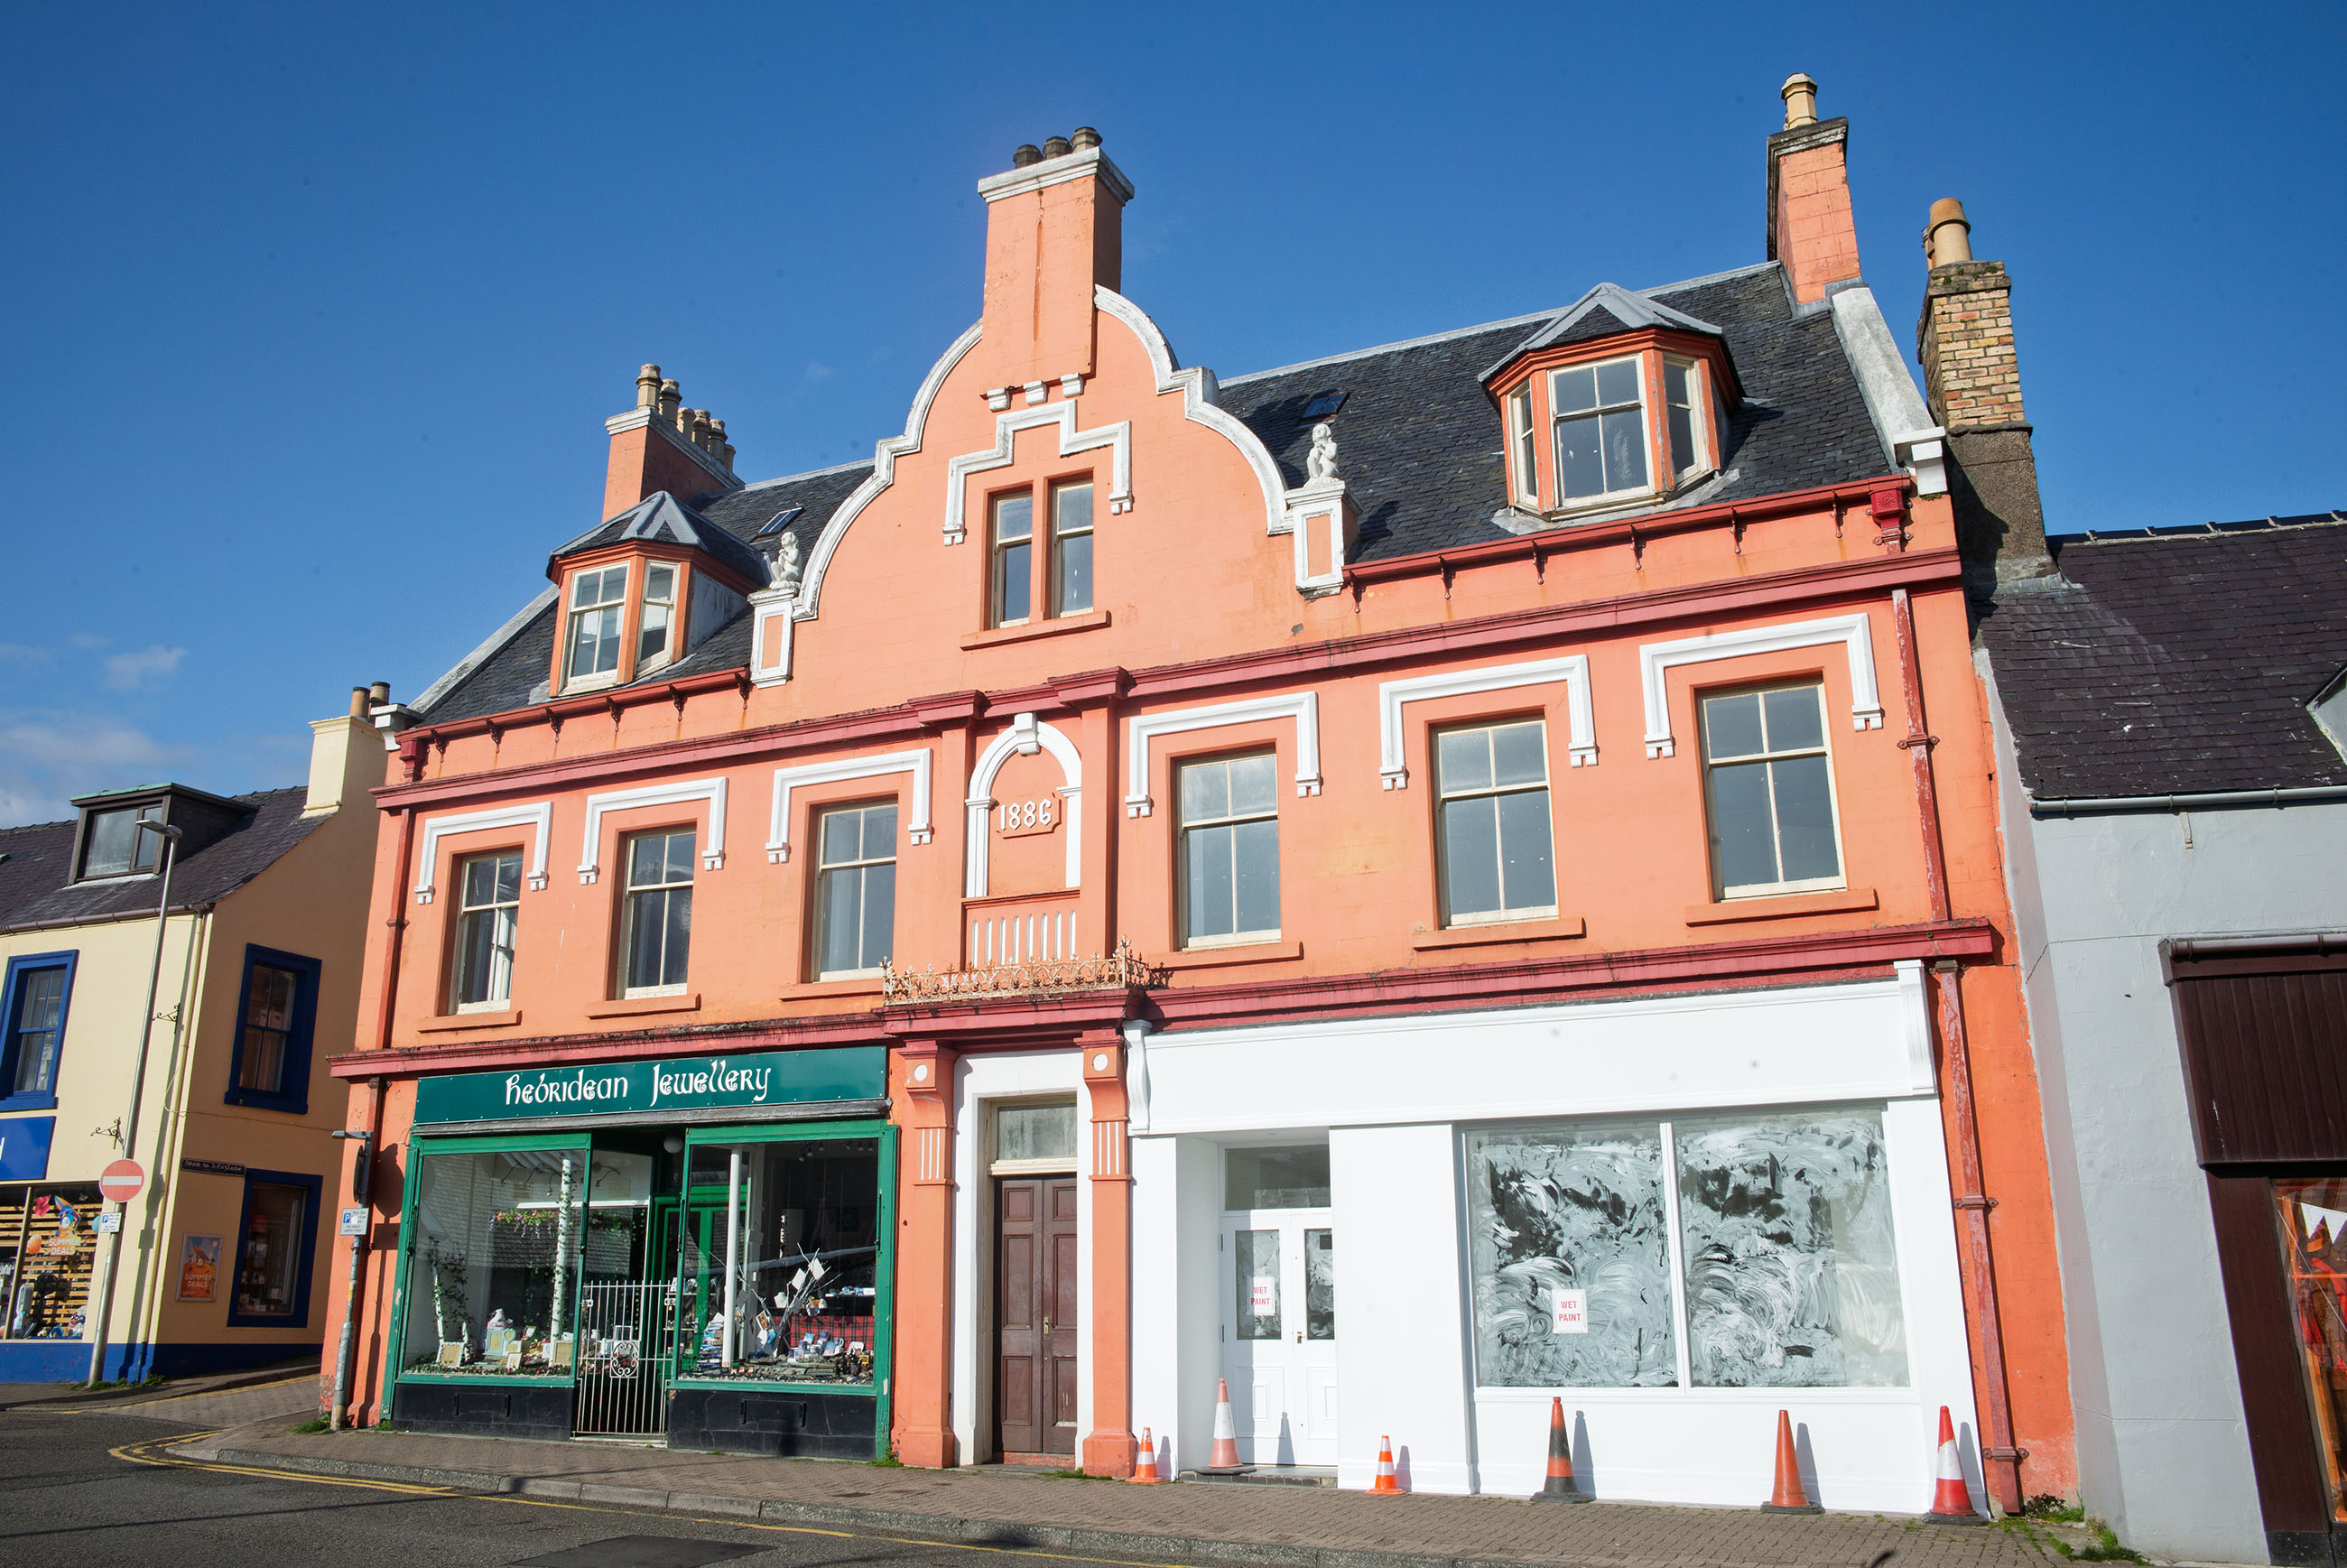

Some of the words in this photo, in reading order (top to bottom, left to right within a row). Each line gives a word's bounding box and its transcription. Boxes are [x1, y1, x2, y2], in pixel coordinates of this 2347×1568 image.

[1000, 798, 1052, 830] 1886
[649, 1059, 772, 1107] Jewellery
[49, 1238, 81, 1247] SUMMER
[51, 1247, 75, 1255] DEALS
[1250, 1297, 1271, 1305] PAINT
[1561, 1300, 1578, 1309] WET
[1558, 1313, 1582, 1322] PAINT
